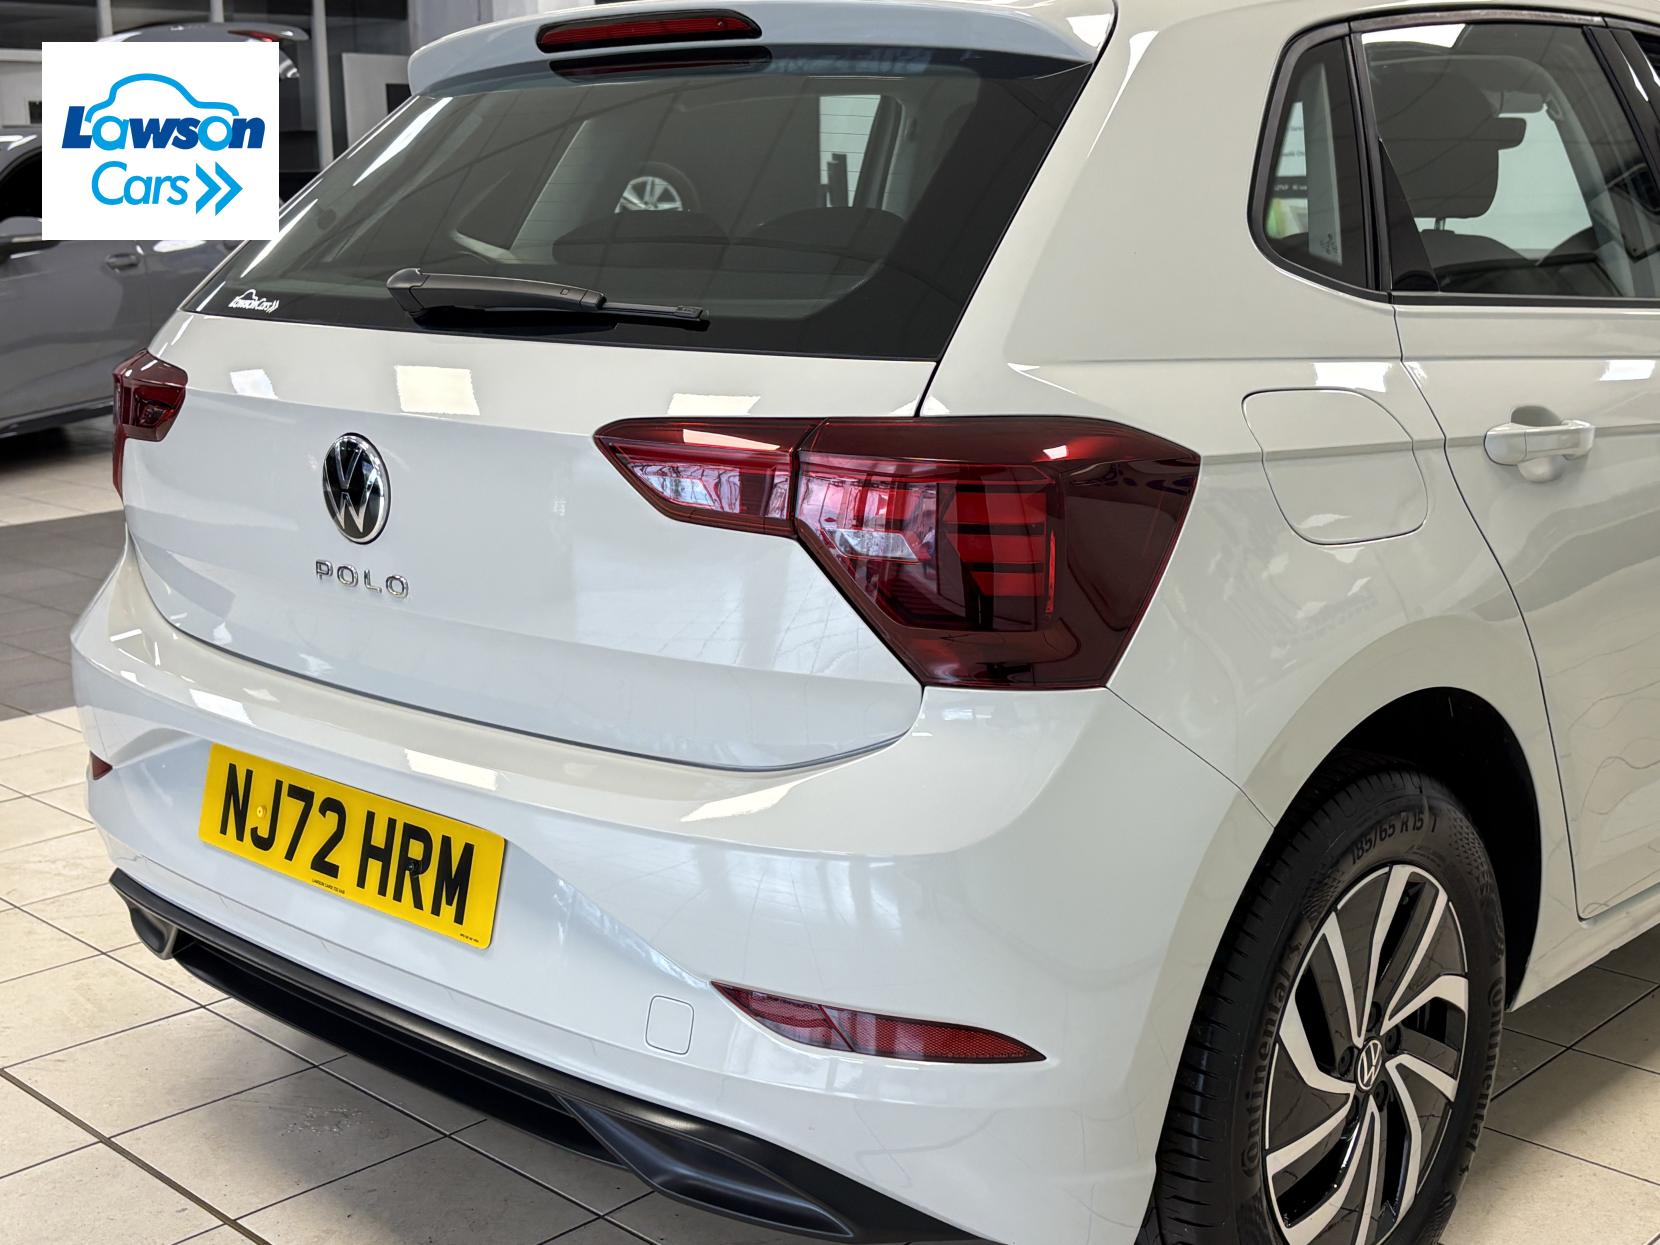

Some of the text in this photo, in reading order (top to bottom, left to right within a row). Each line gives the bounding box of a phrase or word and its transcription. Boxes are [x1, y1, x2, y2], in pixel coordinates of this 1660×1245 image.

[315, 558, 409, 599] POLO
[219, 763, 475, 926] NJ72 HRM
